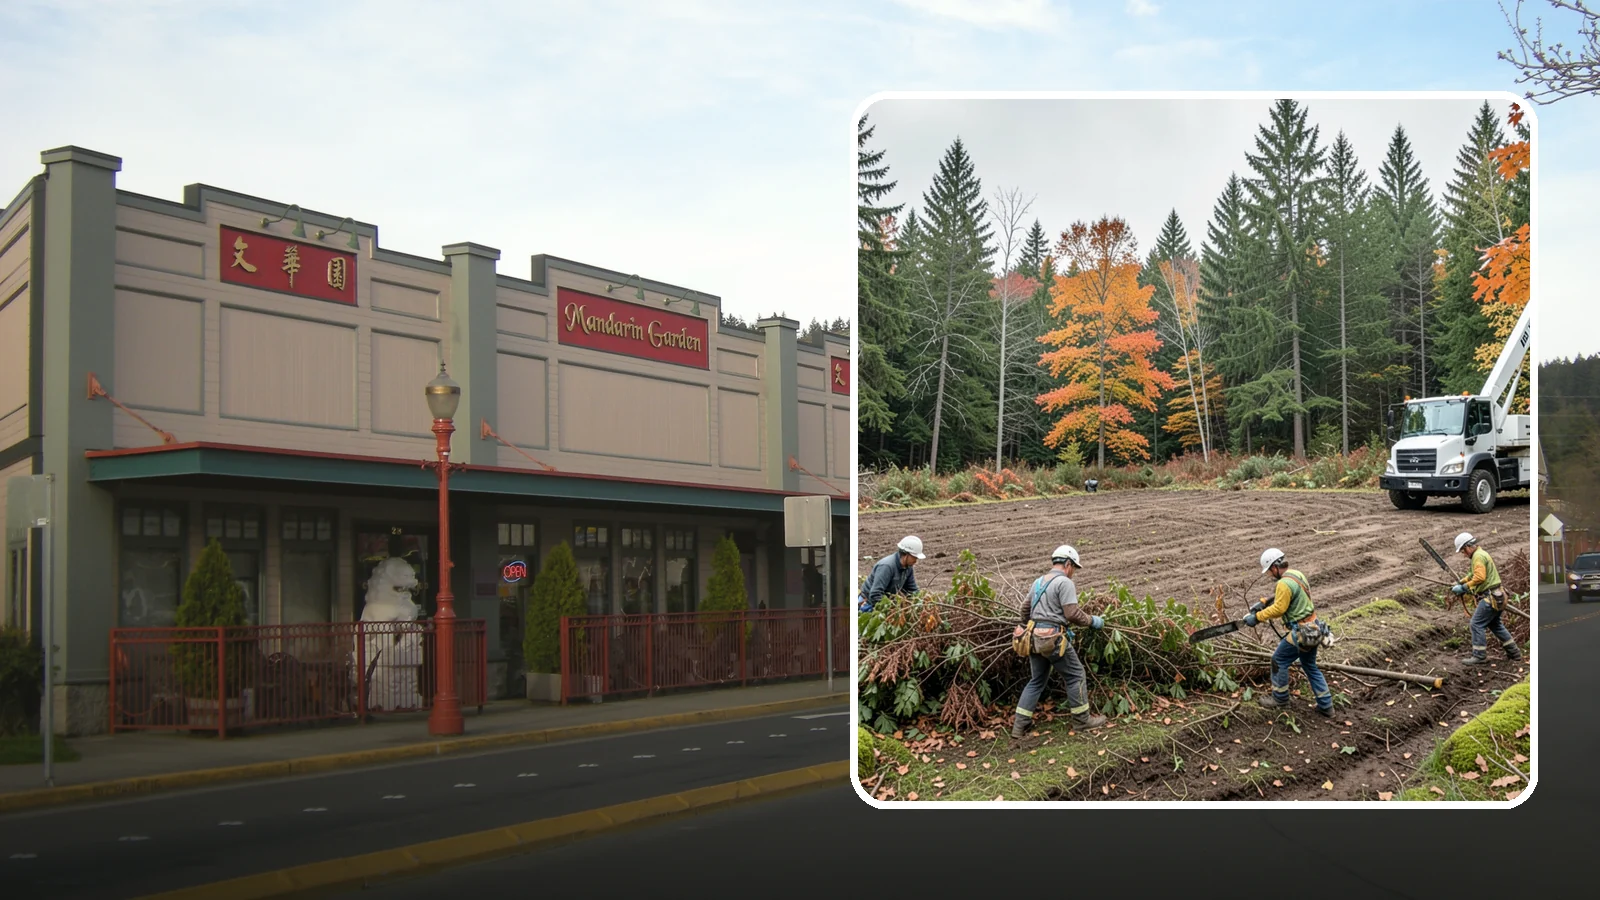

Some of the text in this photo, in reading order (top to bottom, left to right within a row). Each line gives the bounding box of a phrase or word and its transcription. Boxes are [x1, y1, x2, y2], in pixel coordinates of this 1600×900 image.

[230, 235, 347, 292] 文華園
[564, 302, 702, 352] Mandarin Garden
[503, 565, 527, 578] OPEN
